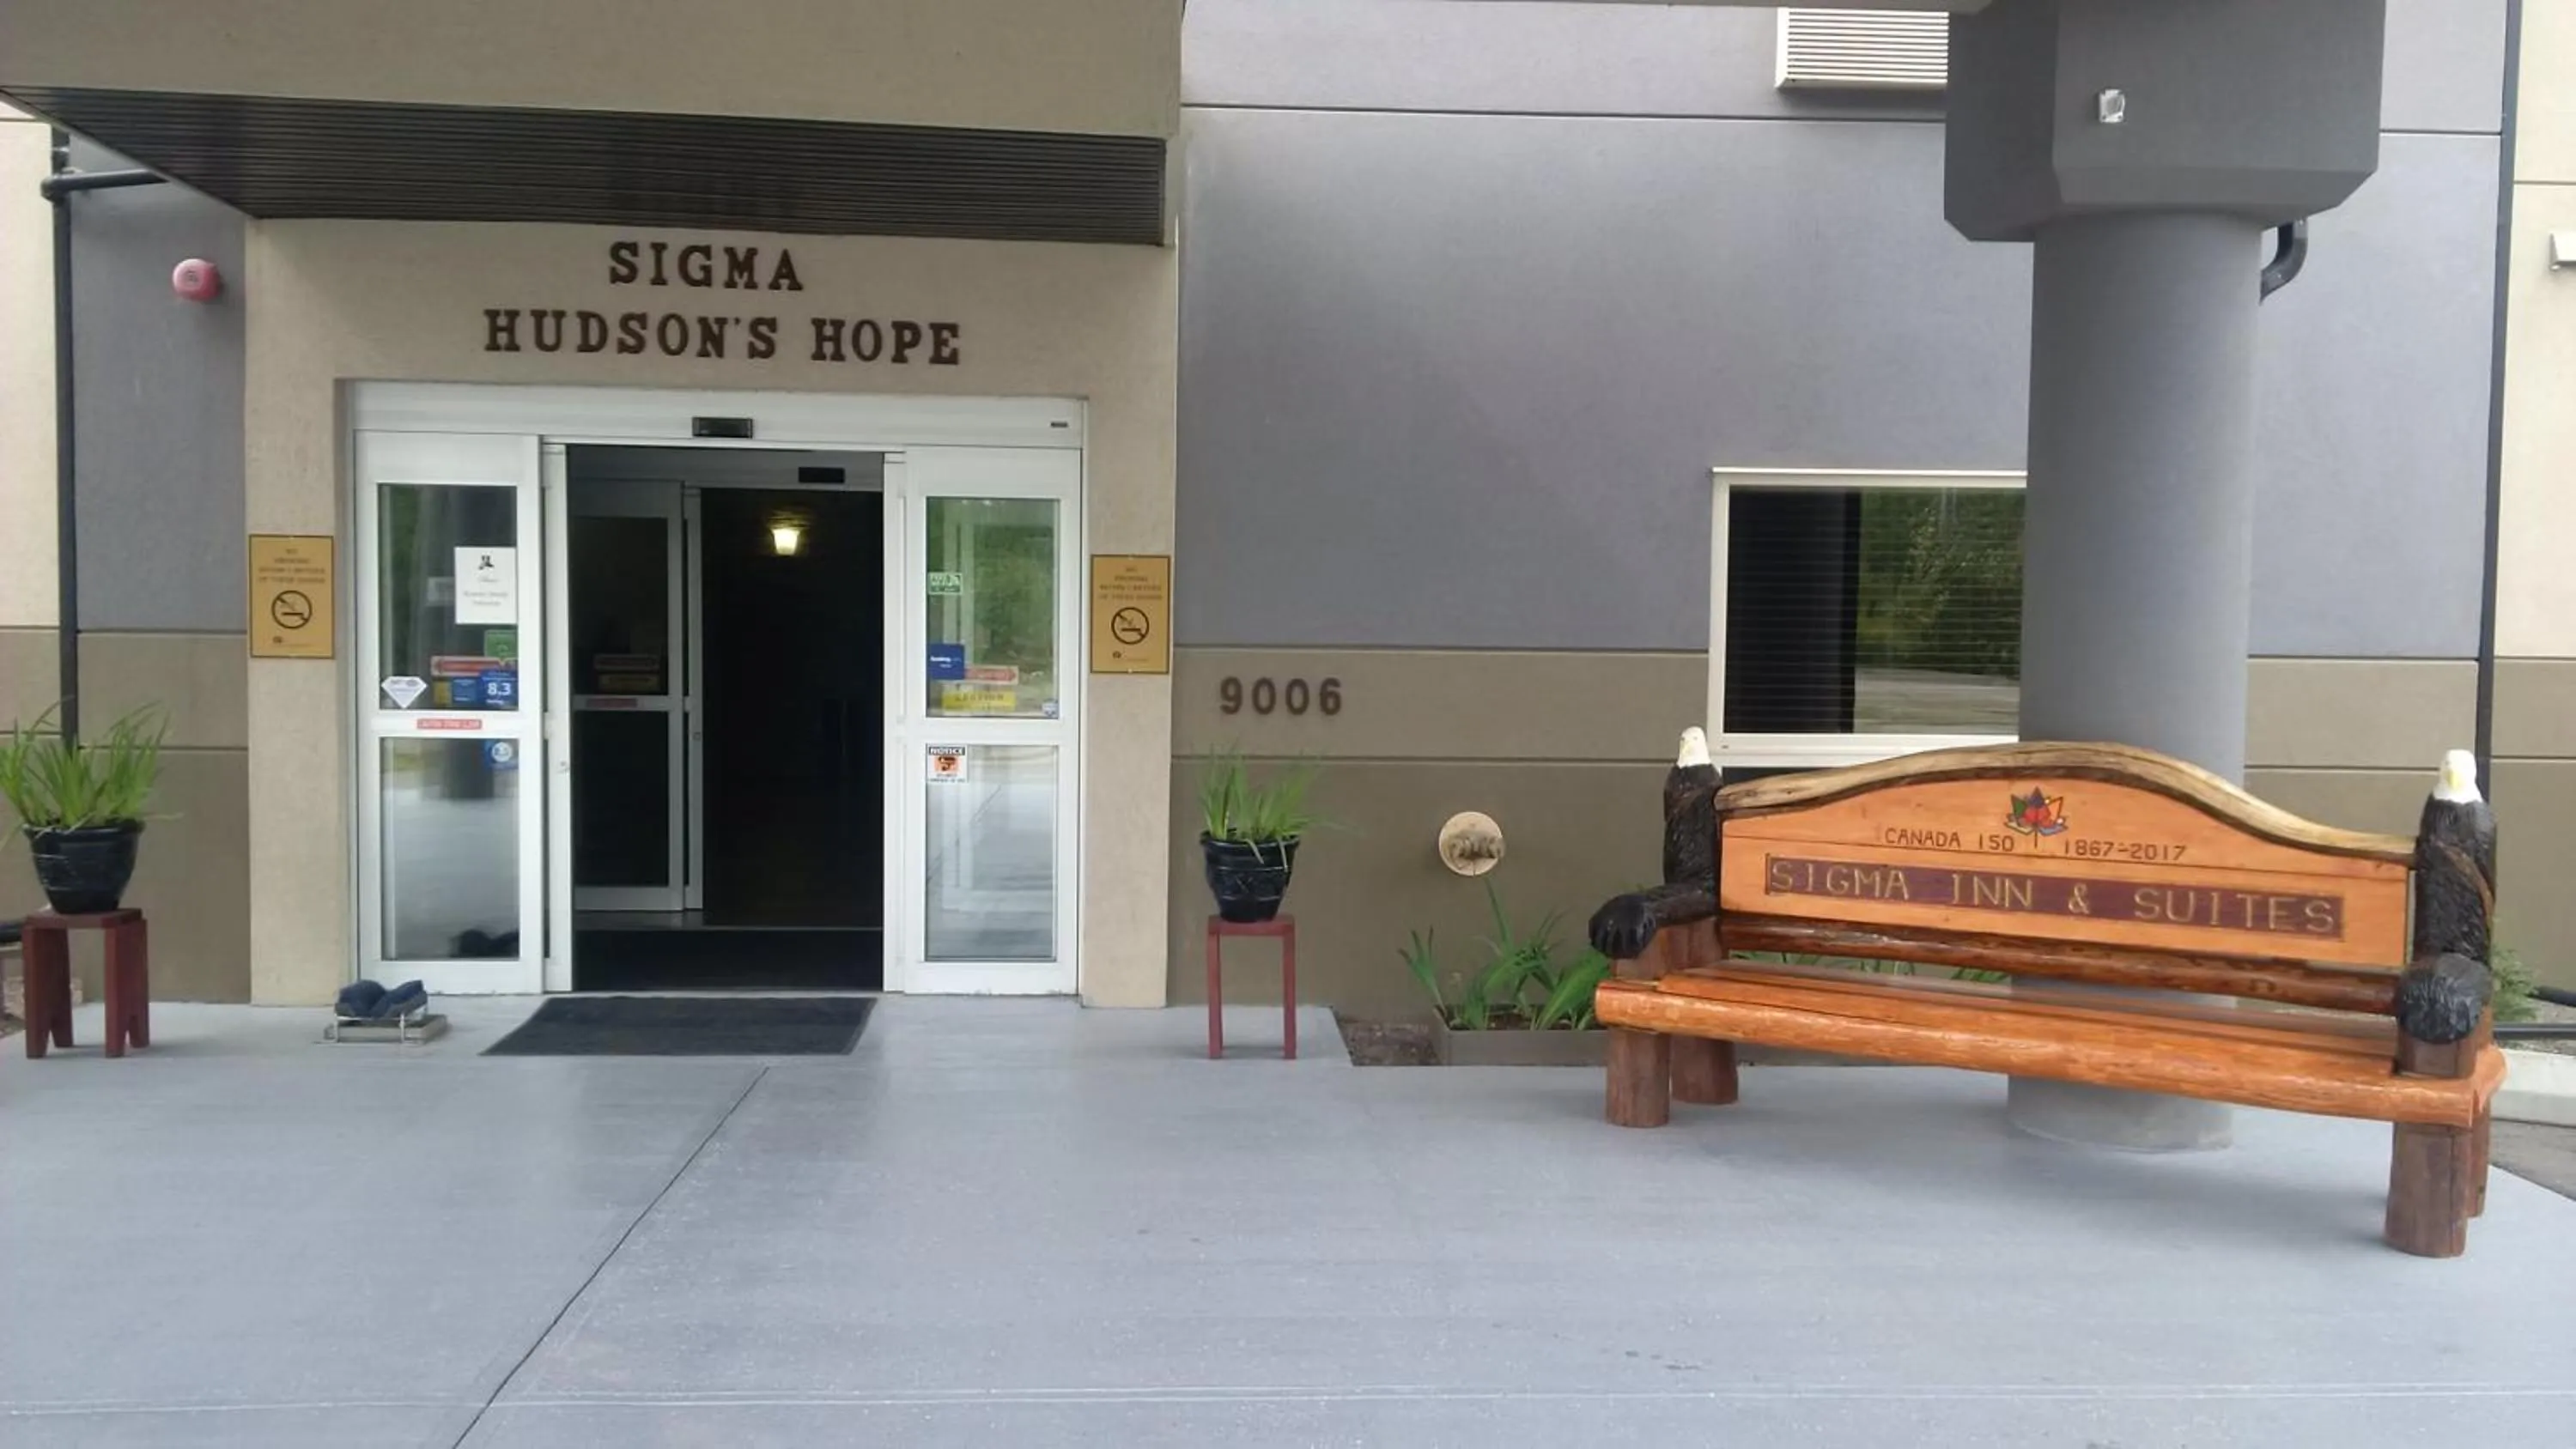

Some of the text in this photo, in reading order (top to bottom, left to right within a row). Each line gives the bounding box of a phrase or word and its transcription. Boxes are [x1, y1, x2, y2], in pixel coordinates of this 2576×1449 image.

[609, 241, 804, 290] SIGMA
[483, 308, 960, 365] HUDSON'S HOPE
[487, 682, 512, 697] 8.3
[1219, 676, 1341, 716] 9006
[1884, 827, 2014, 852] CANADA 150
[2064, 839, 2187, 862] 1867-2017
[1772, 860, 2335, 933] SIGMA INN & SUITES
